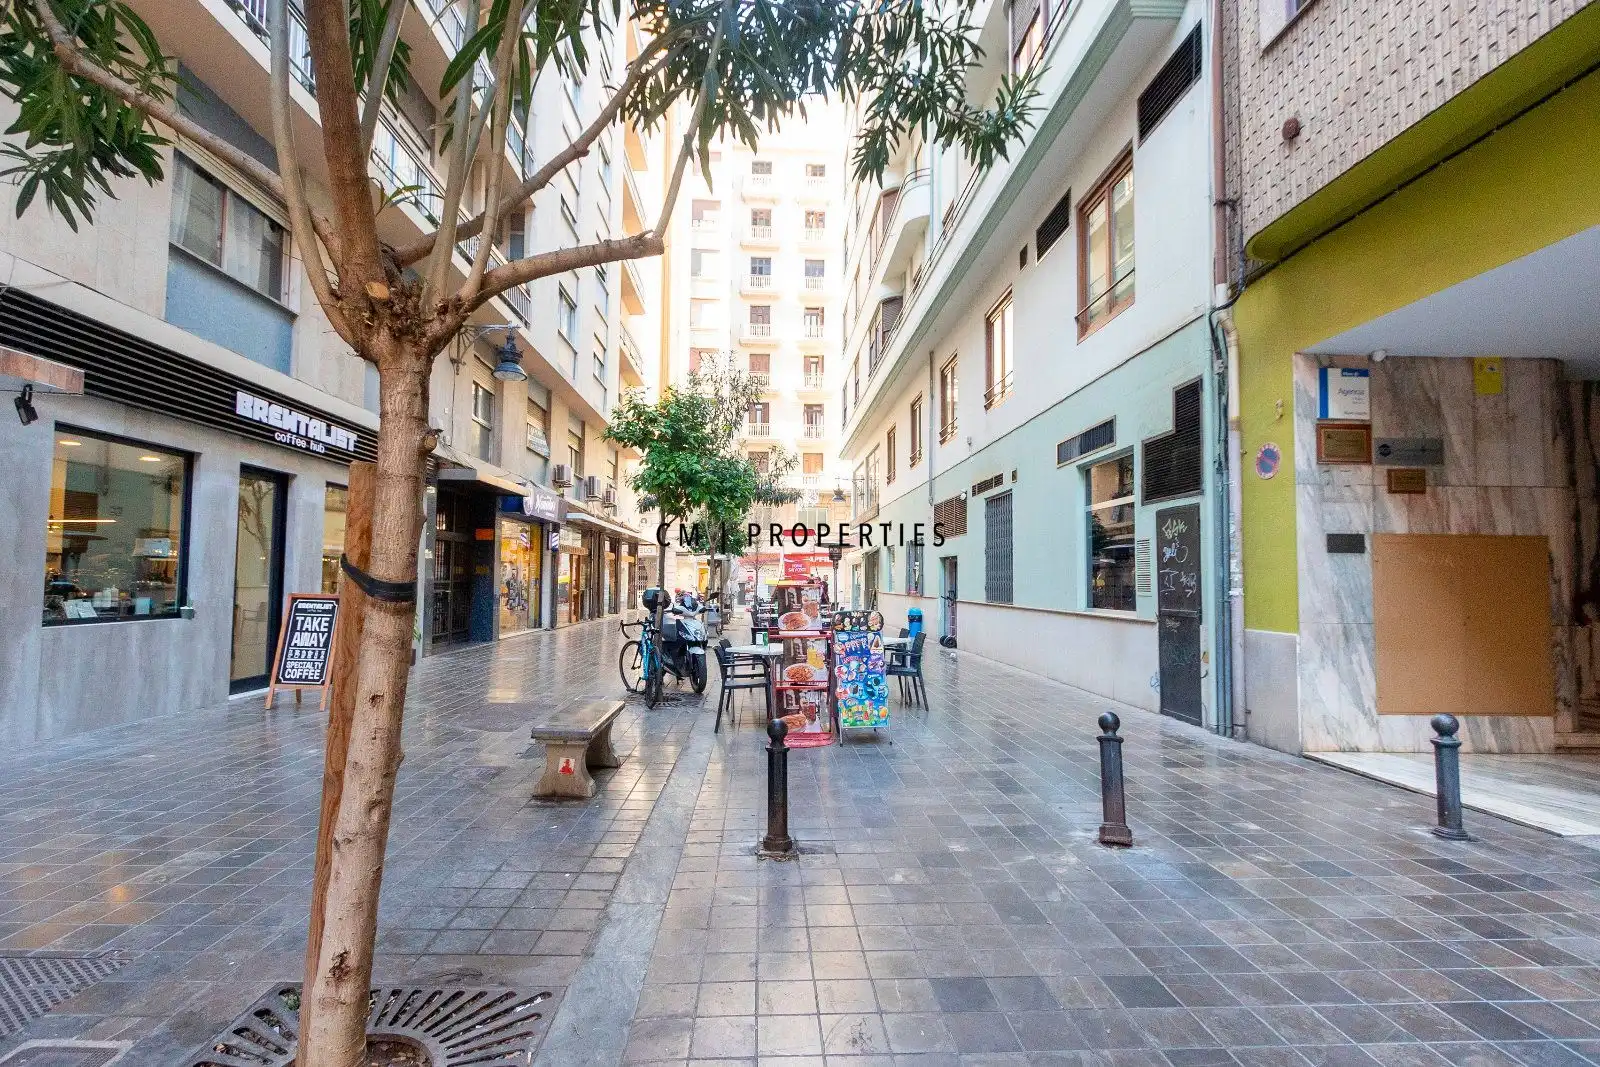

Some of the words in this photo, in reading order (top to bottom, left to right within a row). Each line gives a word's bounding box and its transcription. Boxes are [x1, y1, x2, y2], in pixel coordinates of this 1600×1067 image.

[274, 432, 306, 448] coffee
[310, 441, 325, 453] hub
[296, 617, 330, 631] TAKE
[291, 632, 328, 647] AWAY
[286, 661, 323, 669] SPECIALTY
[285, 669, 320, 679] COFFEE
